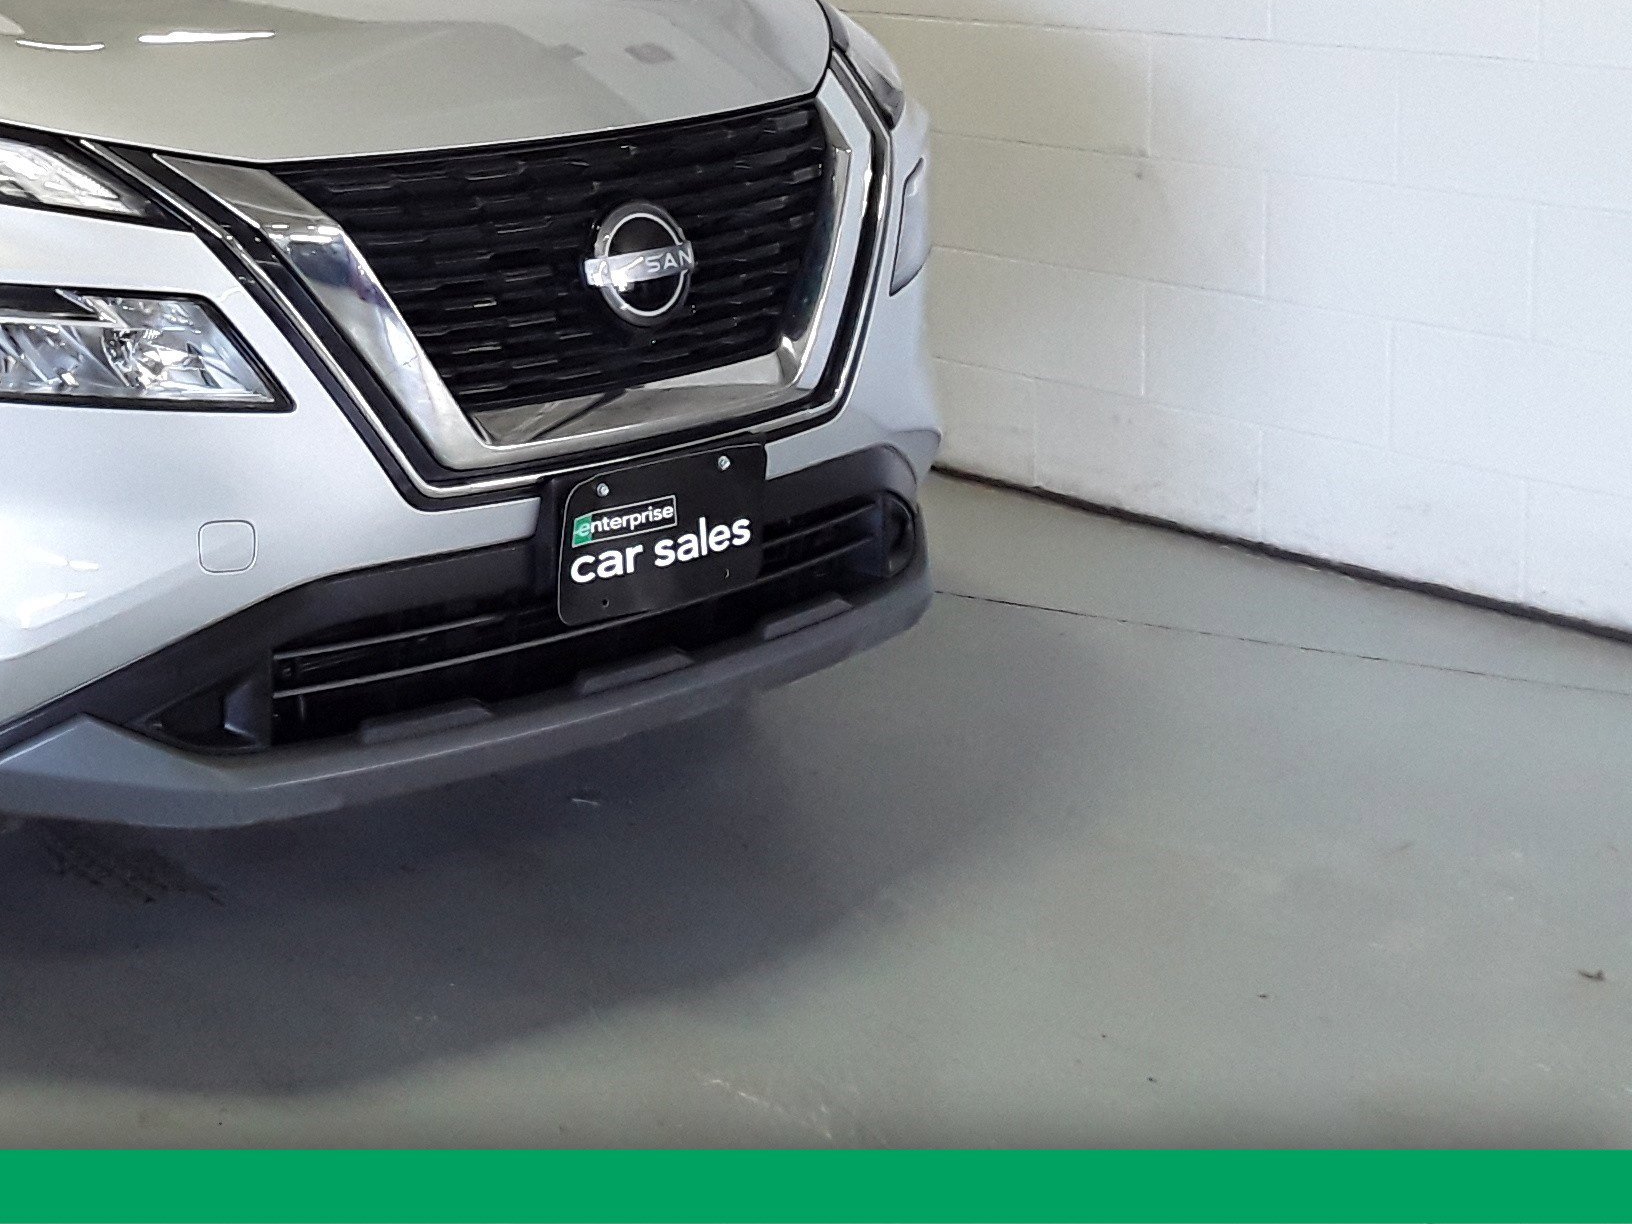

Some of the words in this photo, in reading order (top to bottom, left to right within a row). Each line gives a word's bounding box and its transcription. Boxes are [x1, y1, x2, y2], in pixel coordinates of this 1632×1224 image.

[575, 506, 674, 537] enterprise
[570, 544, 644, 583] car
[654, 517, 752, 567] sales
